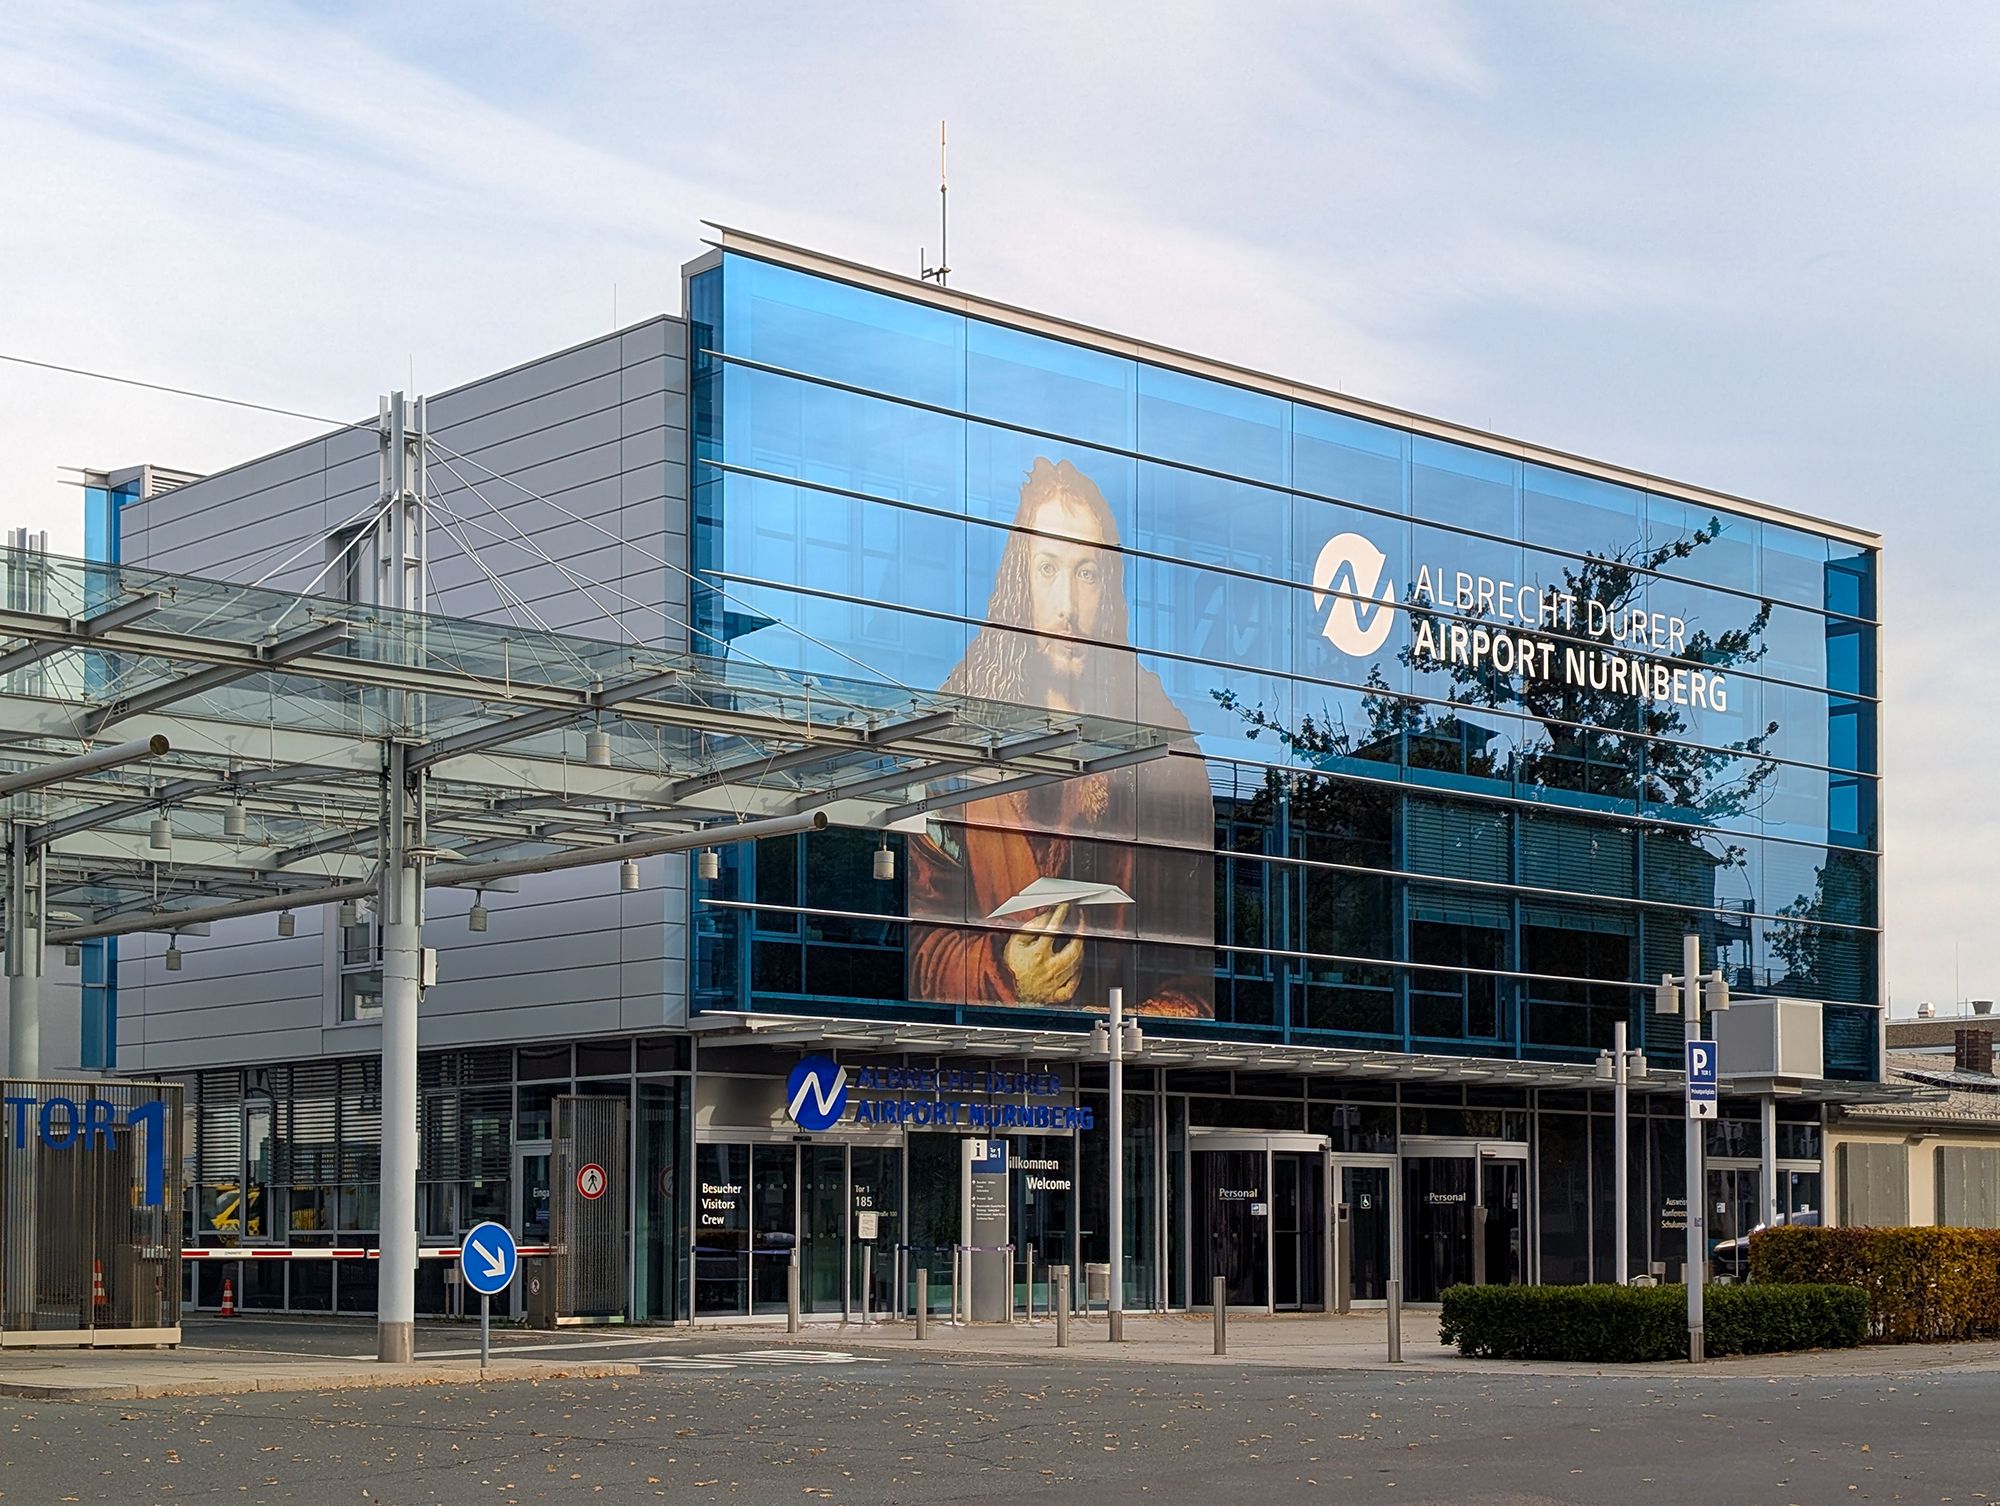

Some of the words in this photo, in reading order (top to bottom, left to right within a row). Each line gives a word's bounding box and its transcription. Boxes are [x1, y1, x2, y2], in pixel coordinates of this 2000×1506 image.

[1413, 564, 1577, 631] ALBRECHT
[1587, 600, 1686, 653] DÜRER
[1413, 619, 1555, 680] AIRPORT
[1566, 647, 1727, 712] NÜRNBERG
[855, 1065, 974, 1092] ALBRECHT
[855, 1100, 960, 1125] AIRPORT
[5, 1097, 117, 1152] TOR
[128, 1101, 165, 1206] 1
[1009, 1156, 1059, 1170] illkommen
[702, 1183, 742, 1194] Besucher
[855, 1184, 865, 1193] Tor
[1026, 1177, 1071, 1190] Welcome
[533, 1187, 550, 1200] Einga
[1219, 1188, 1258, 1198] Personal
[1429, 1192, 1466, 1202] Personal
[701, 1198, 736, 1209] Visitors
[855, 1196, 873, 1207] 185
[702, 1214, 725, 1225] Crew
